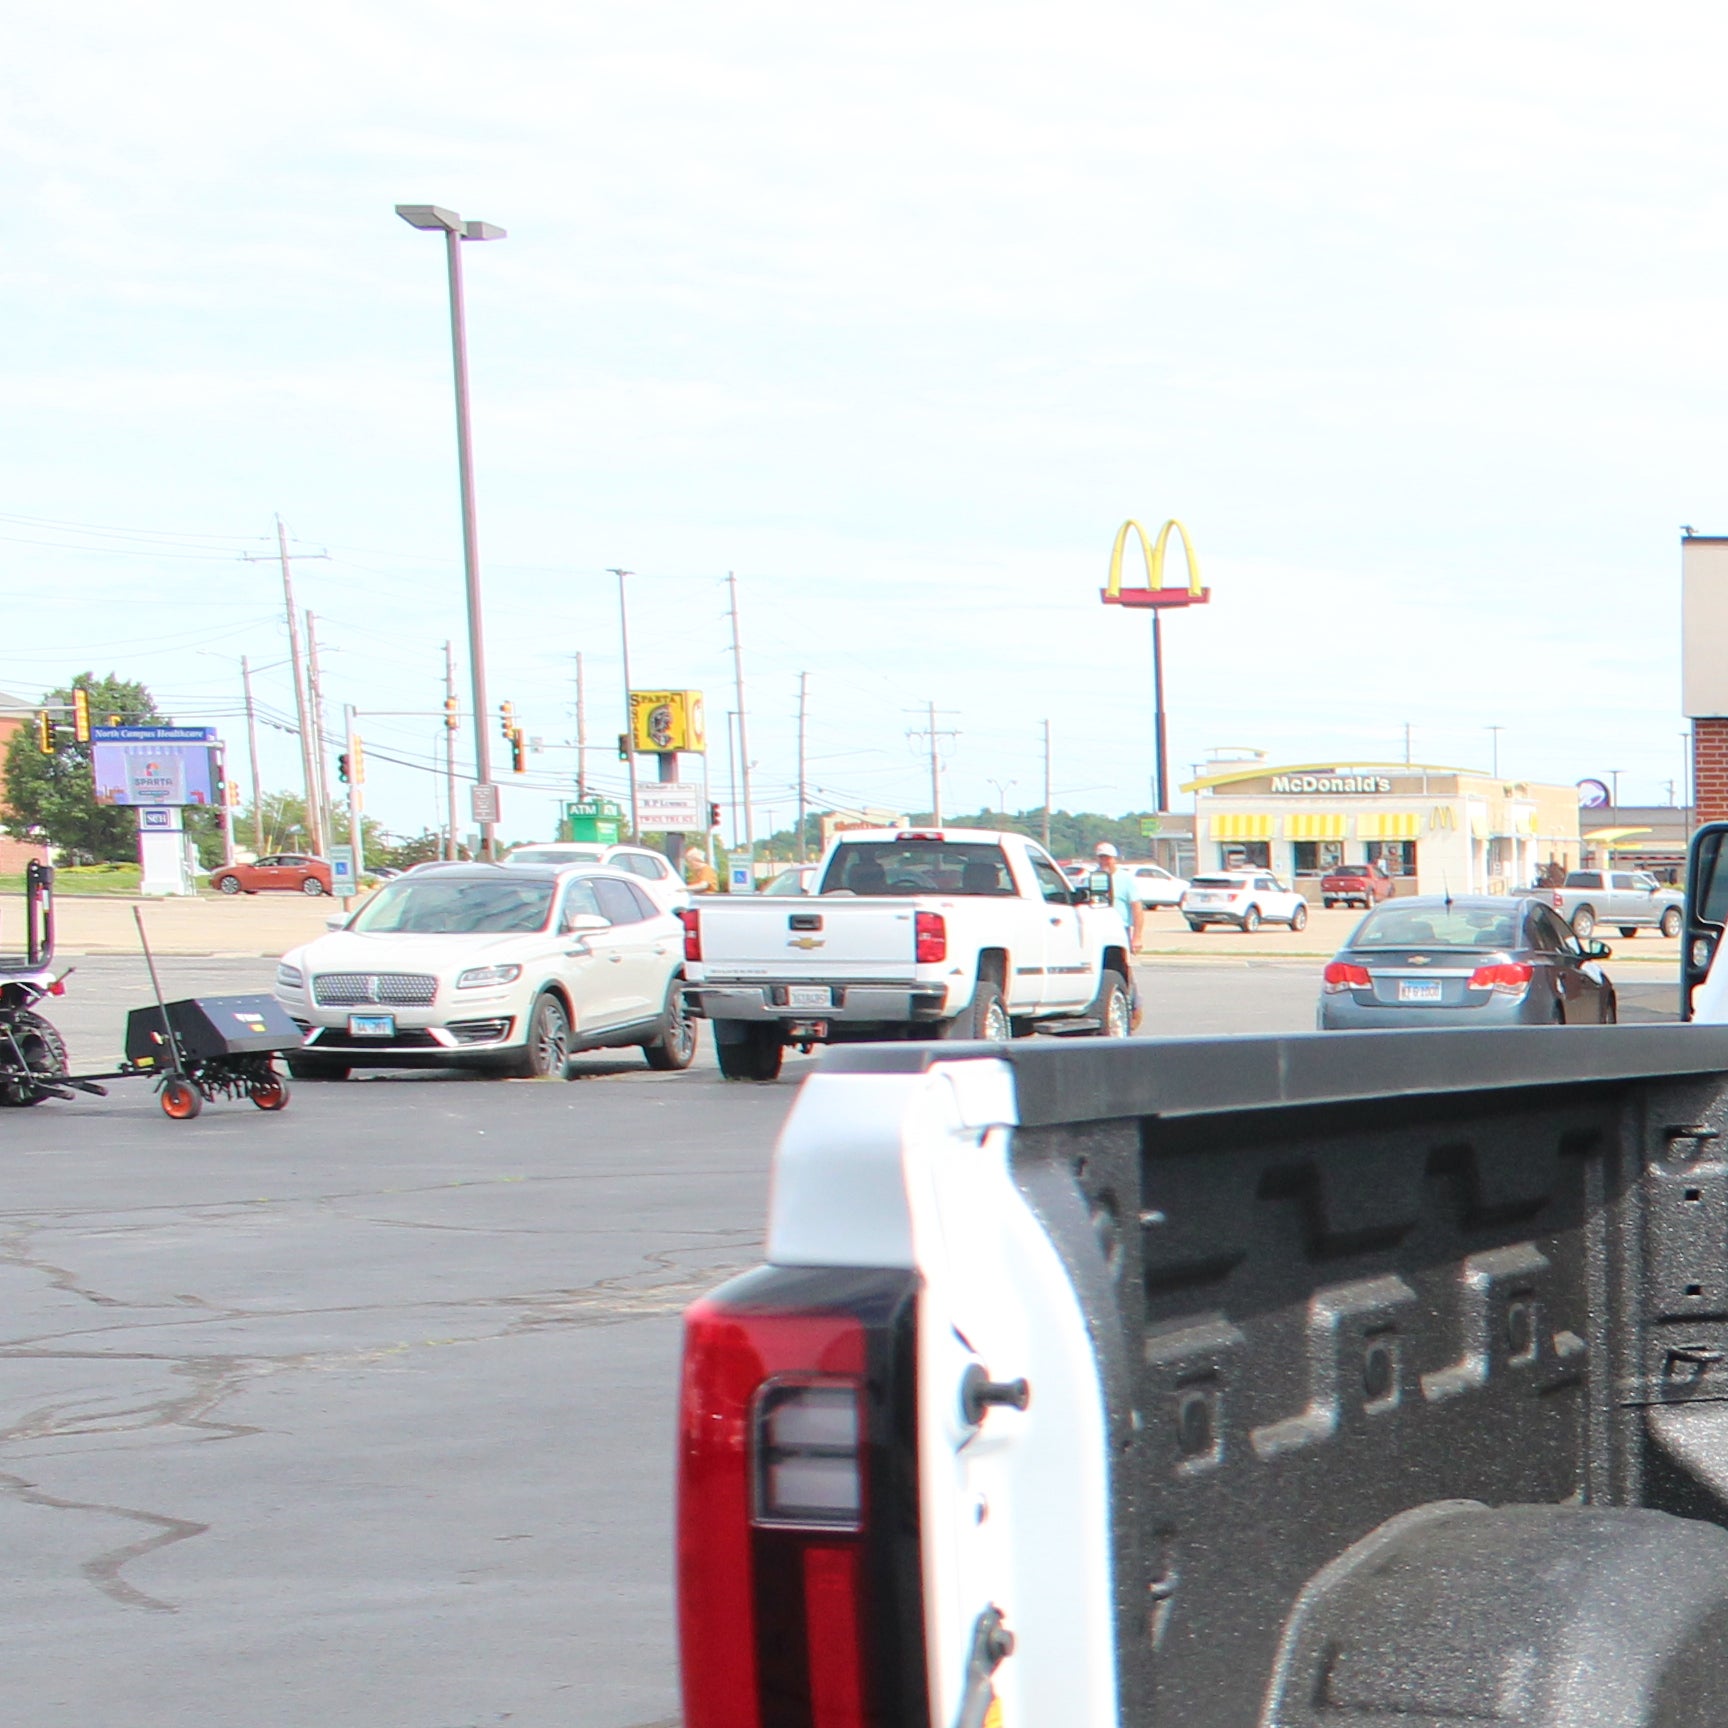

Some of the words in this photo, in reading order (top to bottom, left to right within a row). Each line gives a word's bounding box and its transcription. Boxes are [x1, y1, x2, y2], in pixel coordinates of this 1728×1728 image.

[95, 729, 119, 738] North
[120, 729, 156, 740] Campus
[157, 729, 204, 739] Healthcare
[135, 778, 173, 786] SPARTA
[1270, 775, 1392, 793] McDonald's
[569, 804, 597, 815] ATM
